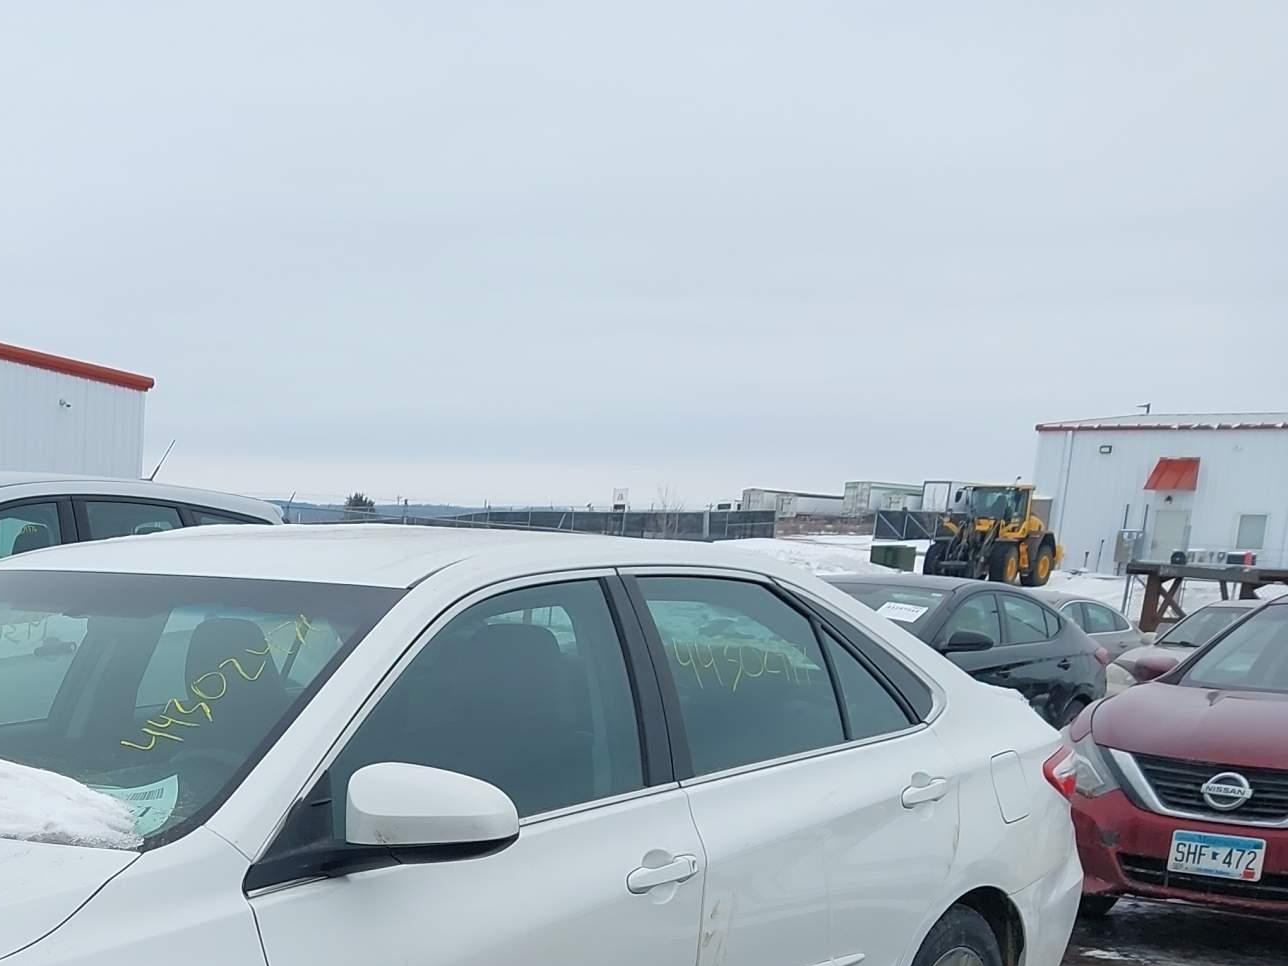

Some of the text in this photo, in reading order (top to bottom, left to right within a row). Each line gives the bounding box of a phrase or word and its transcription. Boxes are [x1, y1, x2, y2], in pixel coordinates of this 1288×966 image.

[1205, 785, 1246, 796] NISSAN
[1174, 841, 1257, 871] SHF 472
